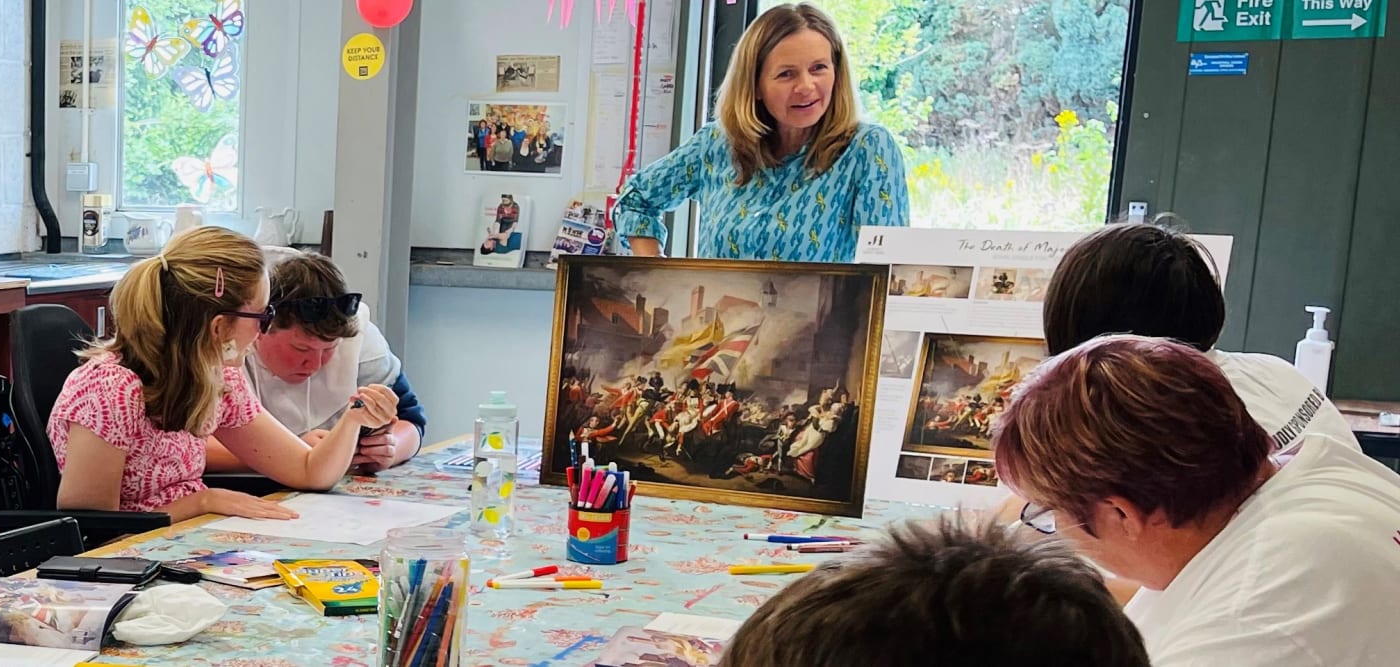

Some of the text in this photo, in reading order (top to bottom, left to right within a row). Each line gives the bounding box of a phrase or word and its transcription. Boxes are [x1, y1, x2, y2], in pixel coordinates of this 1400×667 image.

[1237, 0, 1273, 8] Fire
[1302, 0, 1372, 11] This Way
[1236, 11, 1271, 26] Exit
[959, 240, 1065, 257] The Death of Majo
